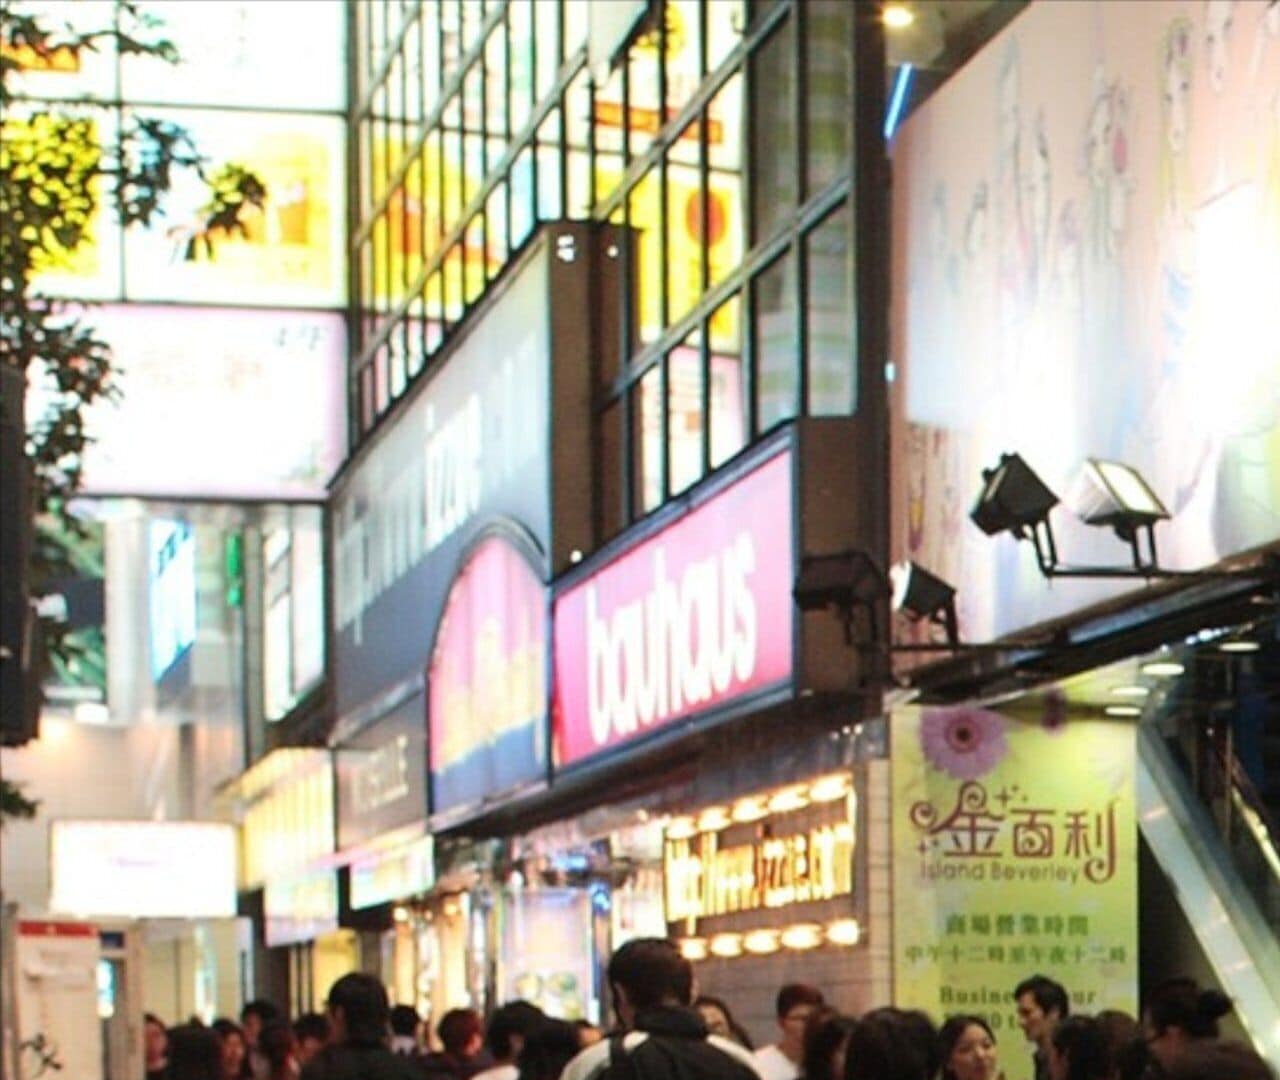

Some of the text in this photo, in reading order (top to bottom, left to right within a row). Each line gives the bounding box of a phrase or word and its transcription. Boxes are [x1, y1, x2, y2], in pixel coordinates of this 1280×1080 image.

[585, 531, 758, 745] bauhaus
[910, 781, 1120, 884] 金百利
[921, 862, 1080, 884] Island Beverley
